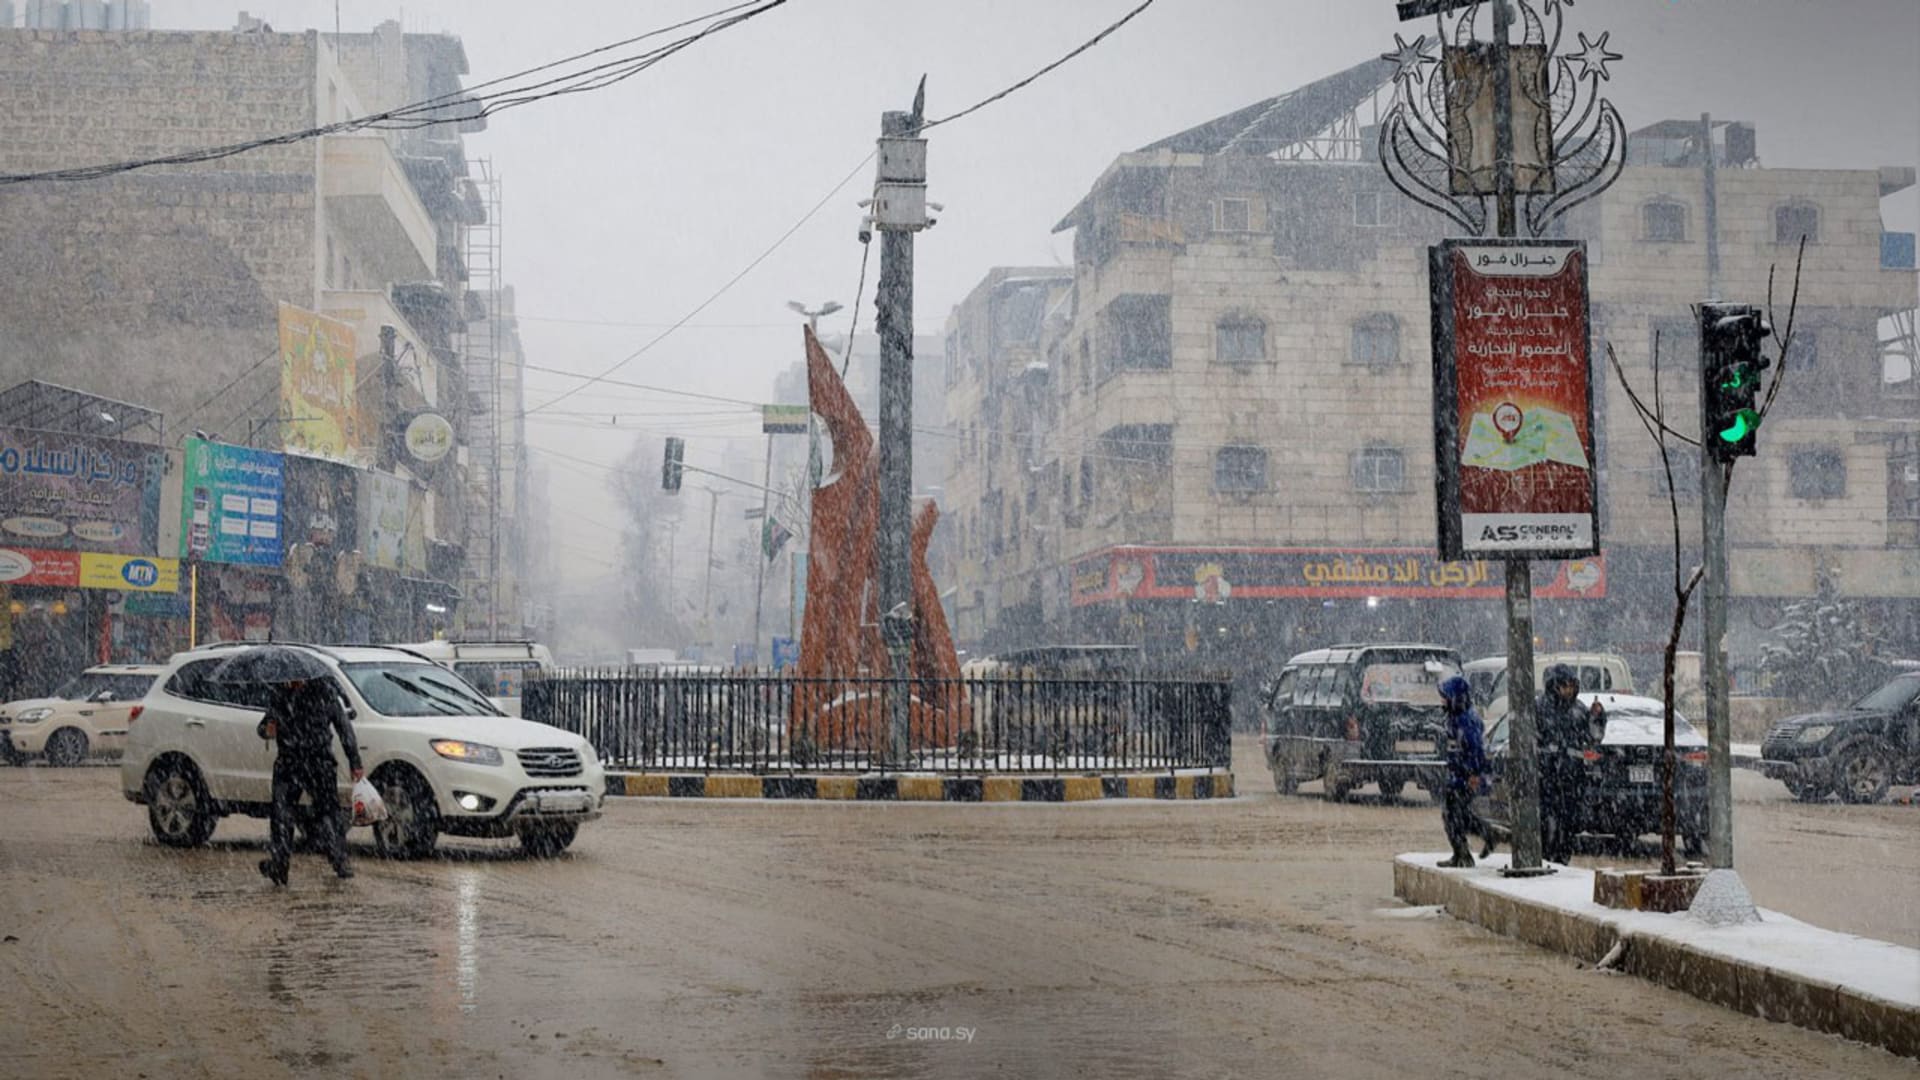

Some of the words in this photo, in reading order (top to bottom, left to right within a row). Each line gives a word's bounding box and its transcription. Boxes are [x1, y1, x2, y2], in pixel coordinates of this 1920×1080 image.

[1476, 253, 1507, 266] فور
[1510, 252, 1556, 267] جنرال
[1480, 524, 1520, 542] AS
[127, 564, 154, 582] MTN
